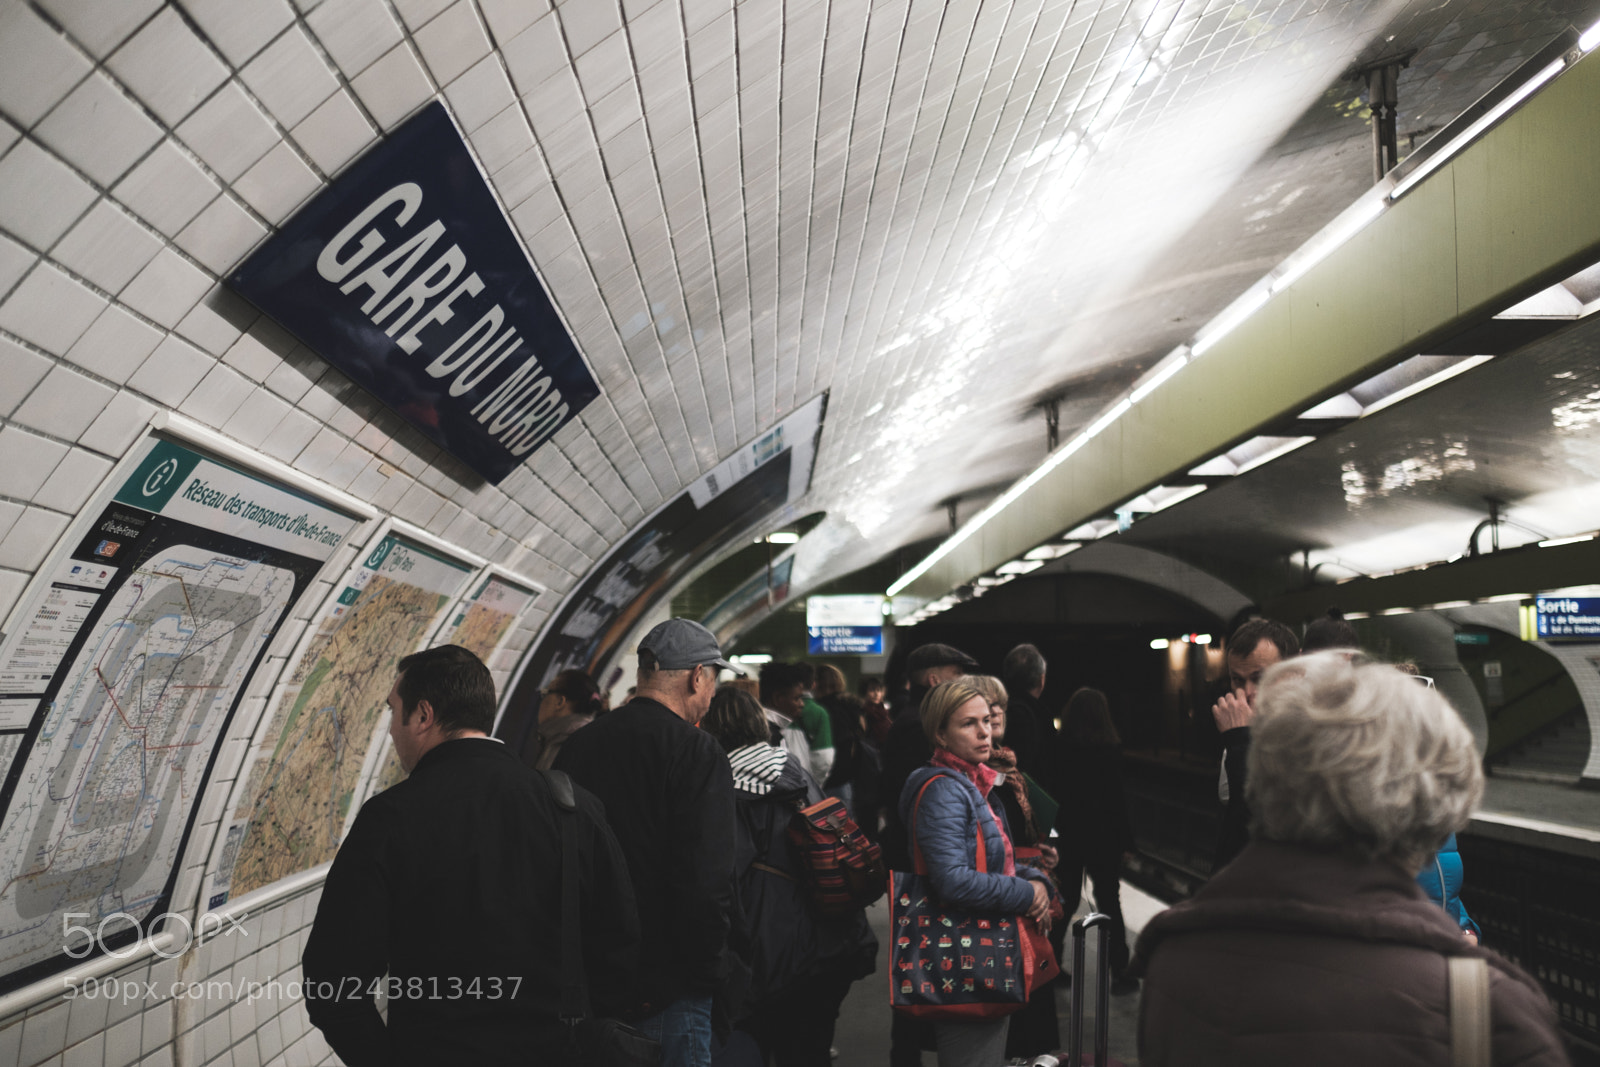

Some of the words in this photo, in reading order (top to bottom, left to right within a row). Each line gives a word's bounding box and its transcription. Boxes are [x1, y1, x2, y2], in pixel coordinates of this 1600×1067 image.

[317, 182, 486, 355] GARE
[425, 304, 524, 397] DU
[470, 355, 570, 457] NORD
[182, 478, 228, 509] Réseau
[222, 493, 246, 516] des
[241, 501, 290, 531] transports
[821, 626, 852, 638] Sortie
[1536, 598, 1579, 613] Sortie
